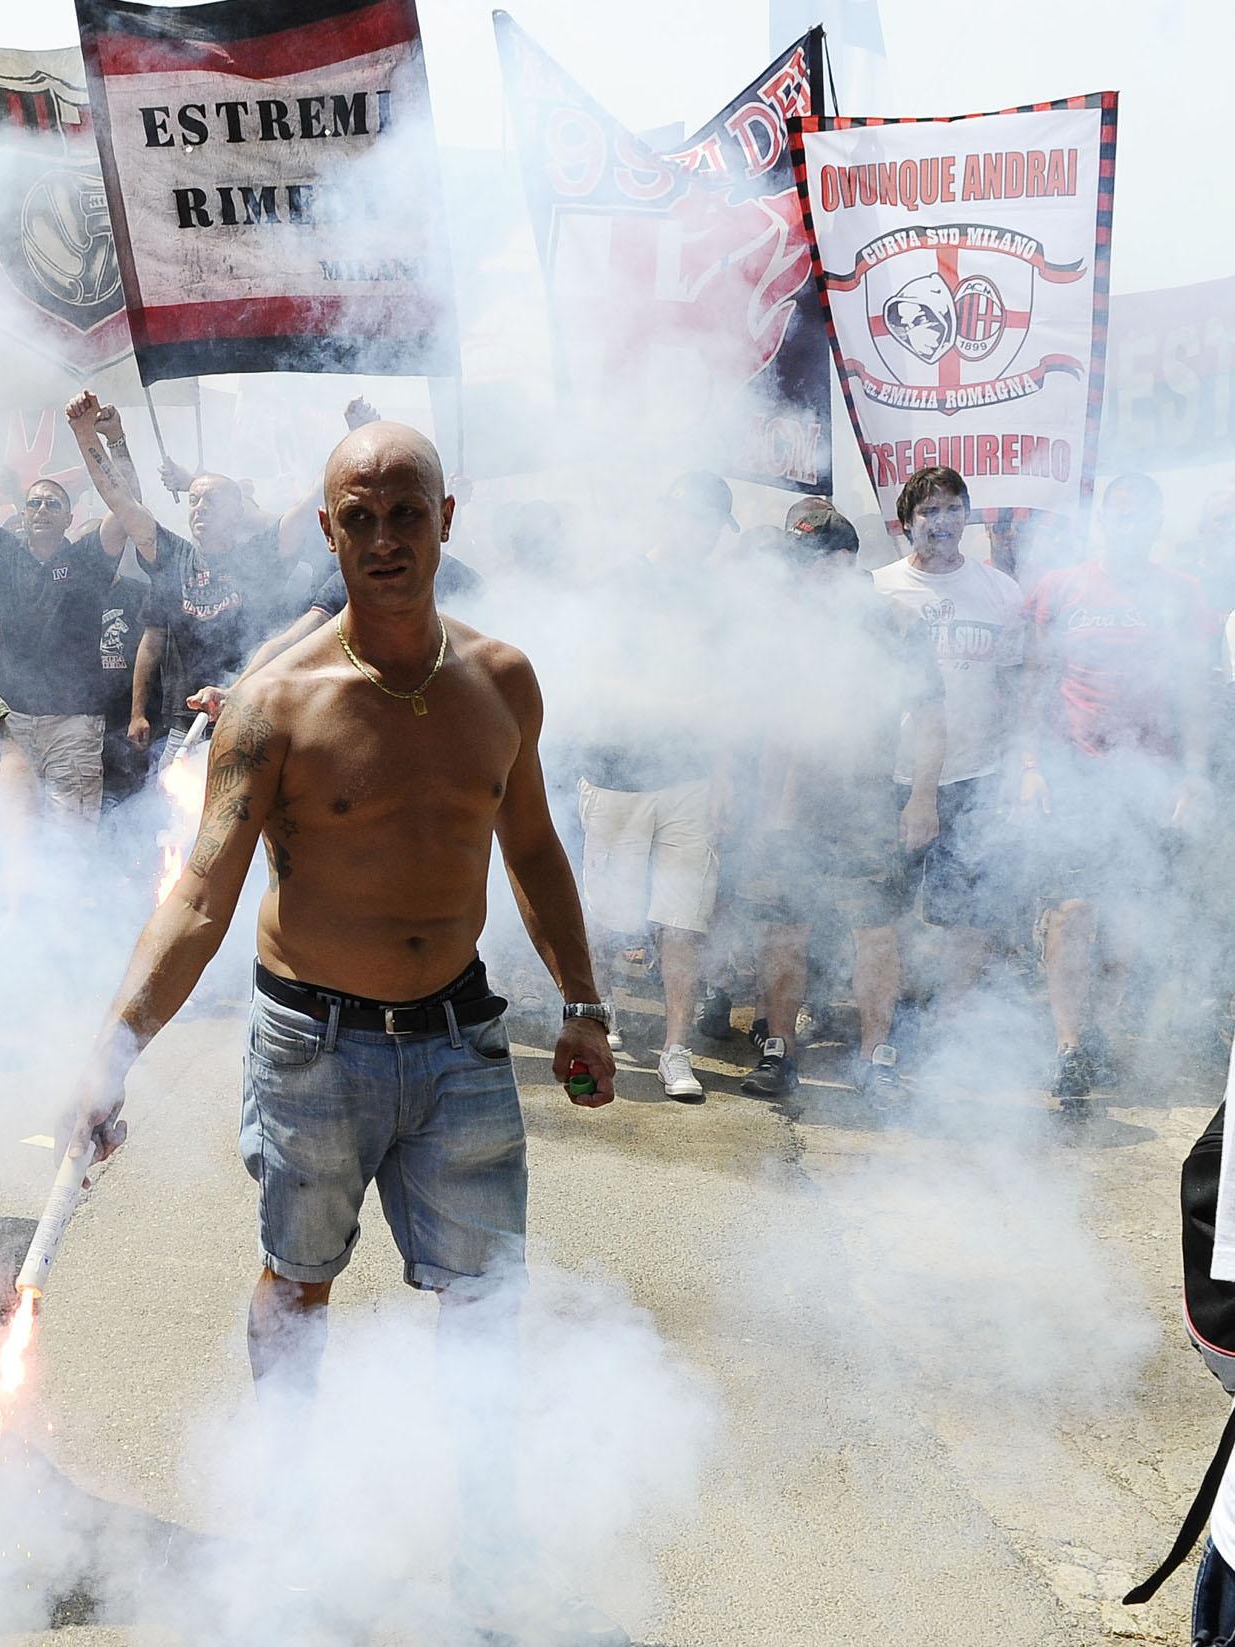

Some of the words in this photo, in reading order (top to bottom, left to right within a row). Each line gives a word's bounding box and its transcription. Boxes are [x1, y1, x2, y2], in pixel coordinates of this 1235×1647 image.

[139, 90, 392, 148] ESTREMI
[820, 155, 956, 212] OVUNQUE
[961, 148, 1078, 202] ANDRAI
[861, 229, 922, 266] CURVA
[926, 227, 960, 246] SUD
[964, 226, 1039, 260] MILANO
[962, 282, 995, 299] ACM
[958, 339, 988, 352] 1899
[877, 383, 939, 409] EMILIA
[945, 372, 1040, 409] ROMAGNA
